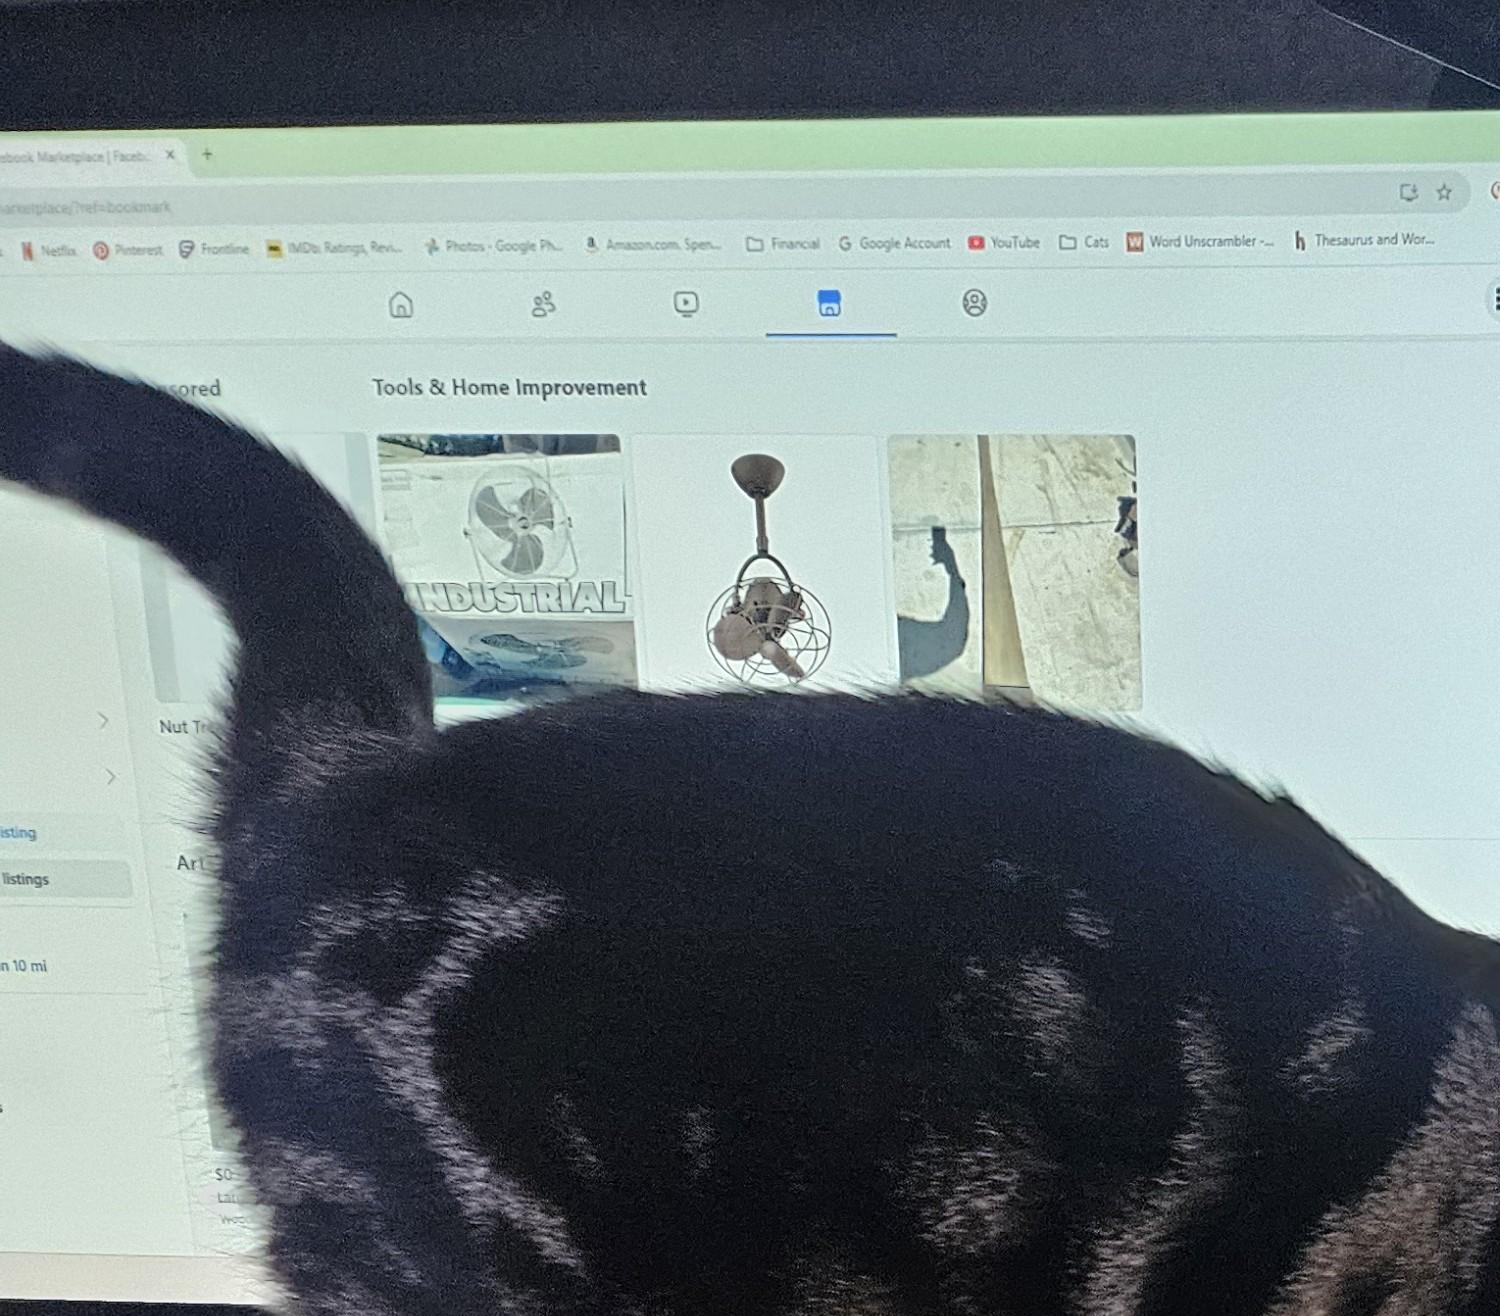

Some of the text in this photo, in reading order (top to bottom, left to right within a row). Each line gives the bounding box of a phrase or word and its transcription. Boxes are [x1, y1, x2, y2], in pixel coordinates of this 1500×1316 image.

[37, 151, 104, 165] Marketplace
[446, 240, 484, 253] Photos
[495, 240, 536, 255] Google
[771, 236, 820, 250] Financial
[860, 236, 900, 254] Google
[904, 236, 951, 250] Account
[991, 236, 1040, 250] YouTube
[1084, 235, 1110, 249] Cats
[1150, 235, 1180, 249] Word
[1184, 234, 1256, 249] Unscrambler
[1315, 233, 1372, 248] Thesaurus
[1376, 233, 1398, 247] and
[41, 245, 76, 256] Netflix
[115, 244, 163, 256] Pinterest
[201, 243, 249, 255] Frontline
[372, 377, 648, 401] Tools & Home Improvement
[404, 581, 627, 613] INDUSTRIAL
[160, 719, 188, 734] Nut
[2, 872, 50, 888] listings
[13, 959, 27, 972] 10
[31, 959, 47, 972] mi
